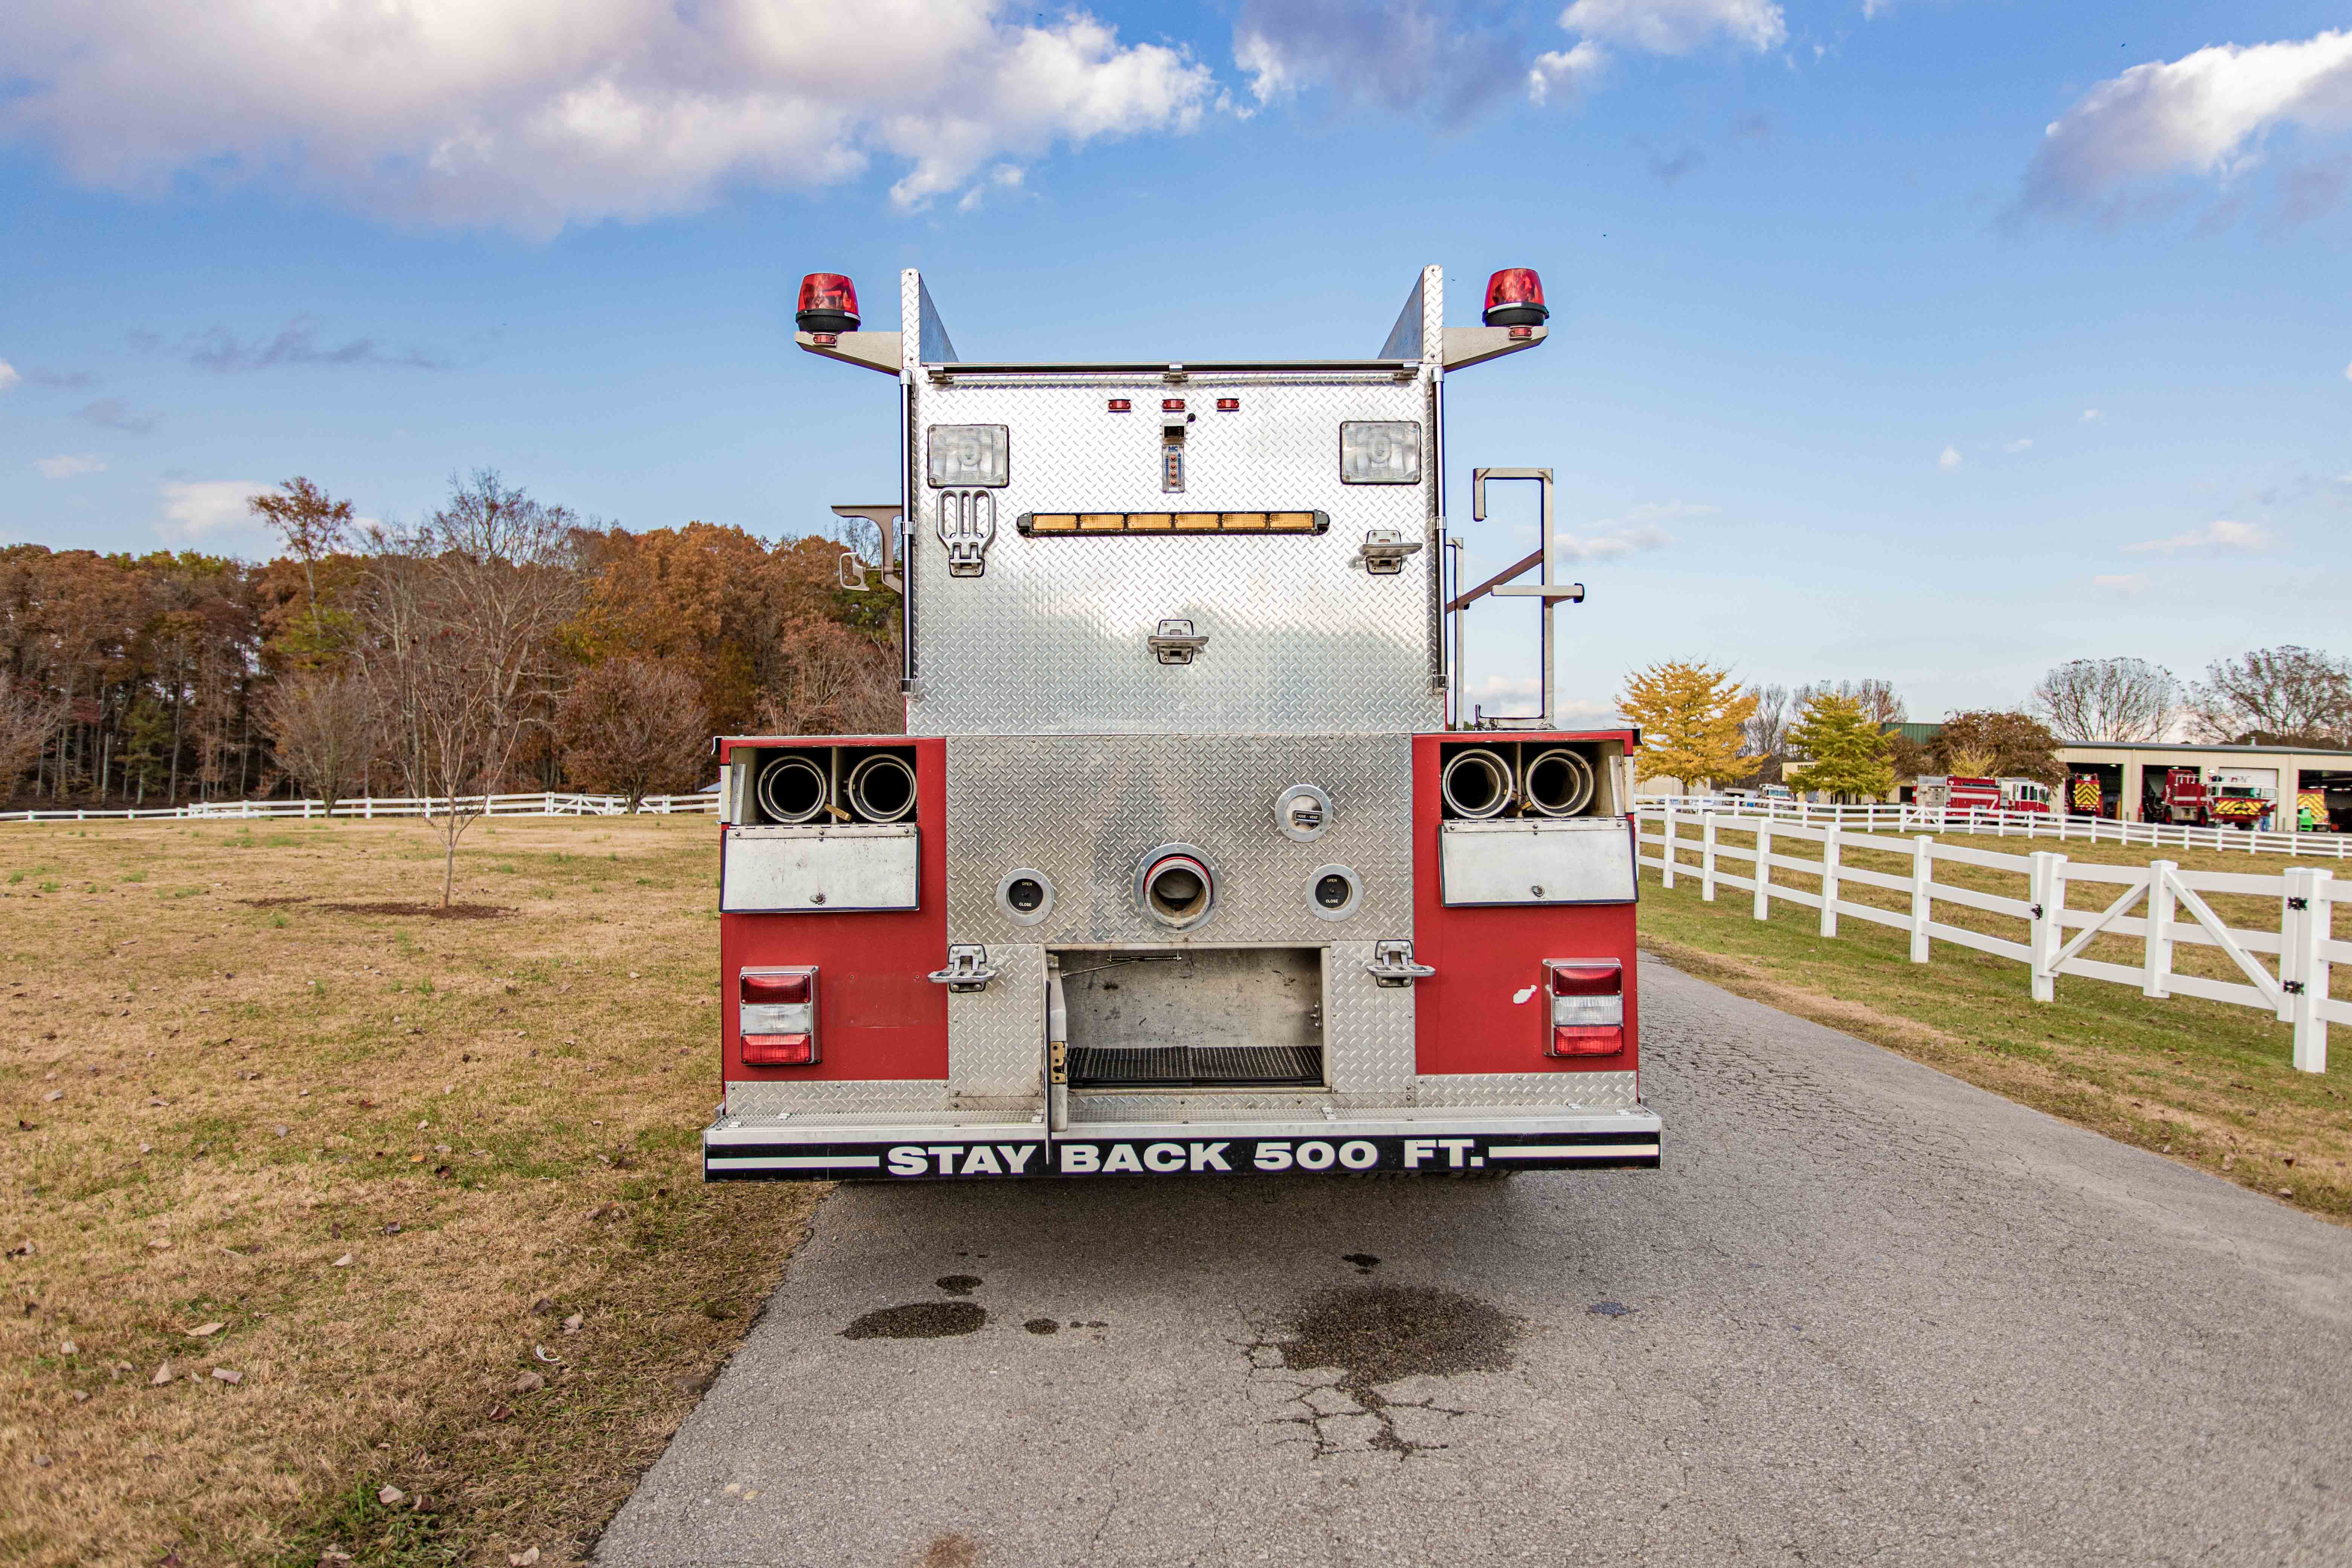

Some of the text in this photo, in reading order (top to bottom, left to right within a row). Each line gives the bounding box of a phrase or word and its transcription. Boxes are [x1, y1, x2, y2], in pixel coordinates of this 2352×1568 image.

[888, 1139, 1483, 1175] STAY BACK 500 FT.
